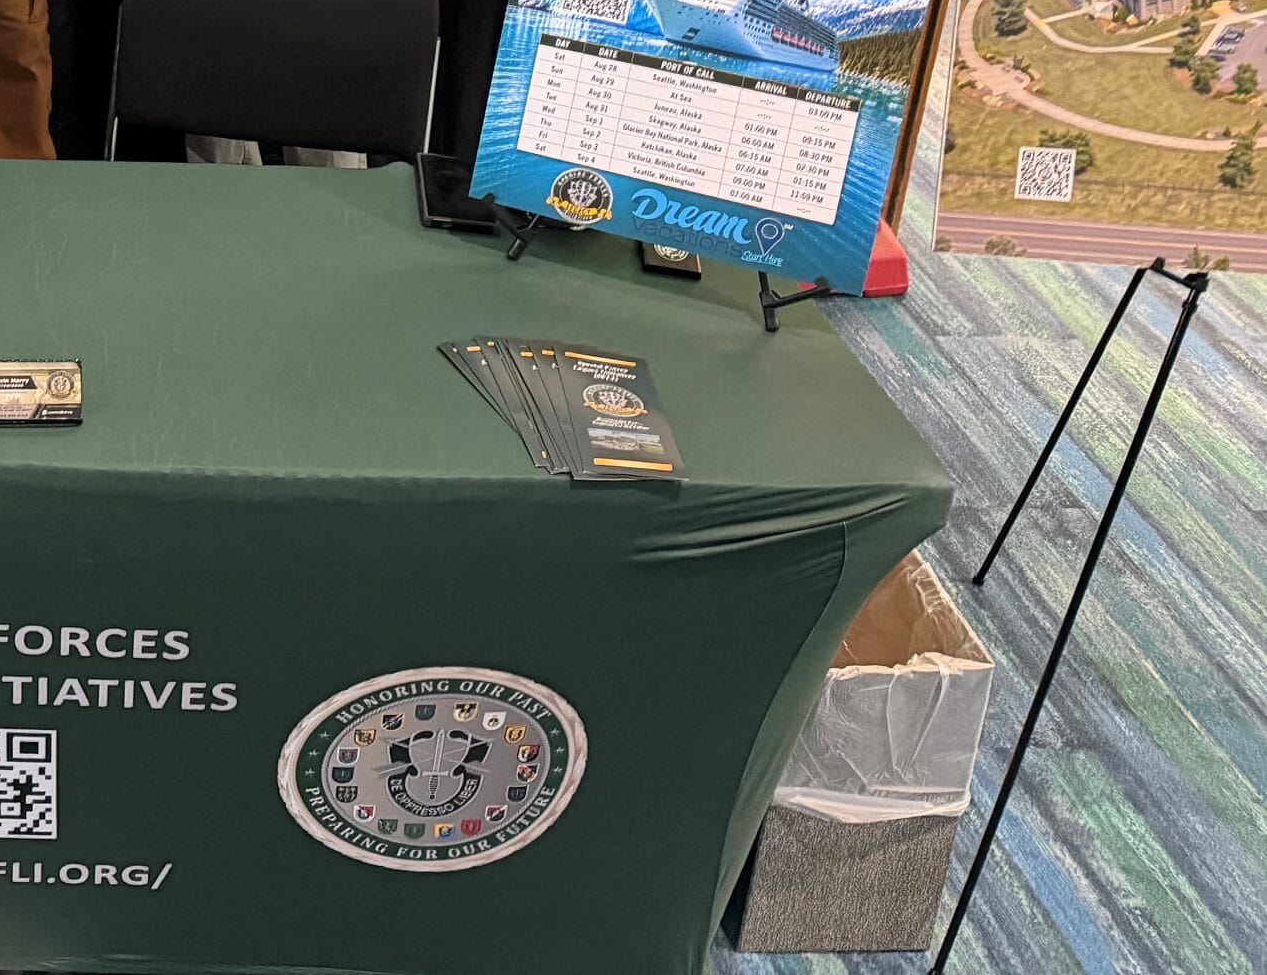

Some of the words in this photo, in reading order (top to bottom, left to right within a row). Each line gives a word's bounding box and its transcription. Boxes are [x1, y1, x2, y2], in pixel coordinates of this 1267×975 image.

[555, 39, 571, 48] DAY
[599, 48, 619, 59] DATE
[661, 60, 681, 74] PORT
[683, 66, 695, 76] OF
[695, 68, 715, 80] CALL
[754, 81, 788, 95] ARRIVAL
[805, 91, 852, 108] DEPARTURE
[679, 80, 717, 95] Washington
[680, 108, 703, 120] Alaska
[679, 122, 701, 134] Alaska
[701, 140, 723, 153] Alaska
[675, 148, 697, 161] Alaska
[654, 158, 675, 170] British
[659, 172, 695, 188] Washington
[632, 188, 751, 244] Dream
[335, 679, 450, 724] HONORING
[459, 680, 504, 700] OUR
[508, 690, 552, 719] PAST
[395, 792, 455, 818] OPPRESSO
[452, 778, 481, 809] LIBER
[305, 786, 389, 855] PREPARING
[396, 846, 438, 860] FOR
[448, 839, 492, 858] OUR
[496, 786, 557, 843] FUTURE
